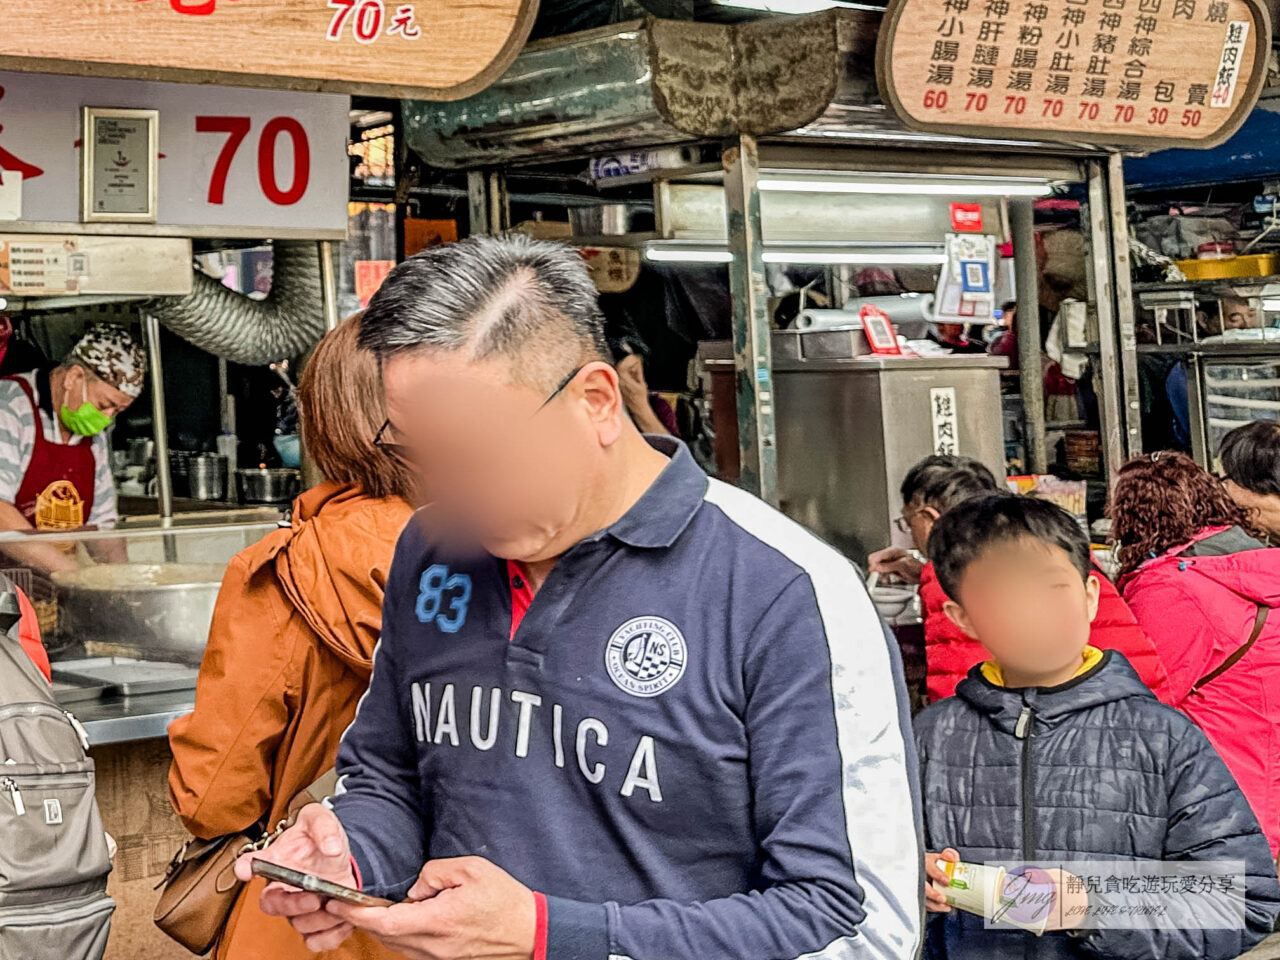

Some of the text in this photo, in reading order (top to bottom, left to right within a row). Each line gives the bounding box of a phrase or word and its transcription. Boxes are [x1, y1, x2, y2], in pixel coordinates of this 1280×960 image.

[386, 5, 421, 39] 元
[922, 89, 949, 110] 60
[964, 92, 989, 112] 70
[1004, 95, 1027, 115] 70
[1041, 98, 1064, 118] 70
[1077, 102, 1100, 121] 70
[1113, 104, 1135, 124] 70
[1147, 107, 1169, 126] 30
[1181, 109, 1202, 128] 50
[195, 115, 312, 206] 70
[415, 563, 472, 634] 83
[649, 641, 667, 656] NS
[410, 682, 663, 803] NAUTICA
